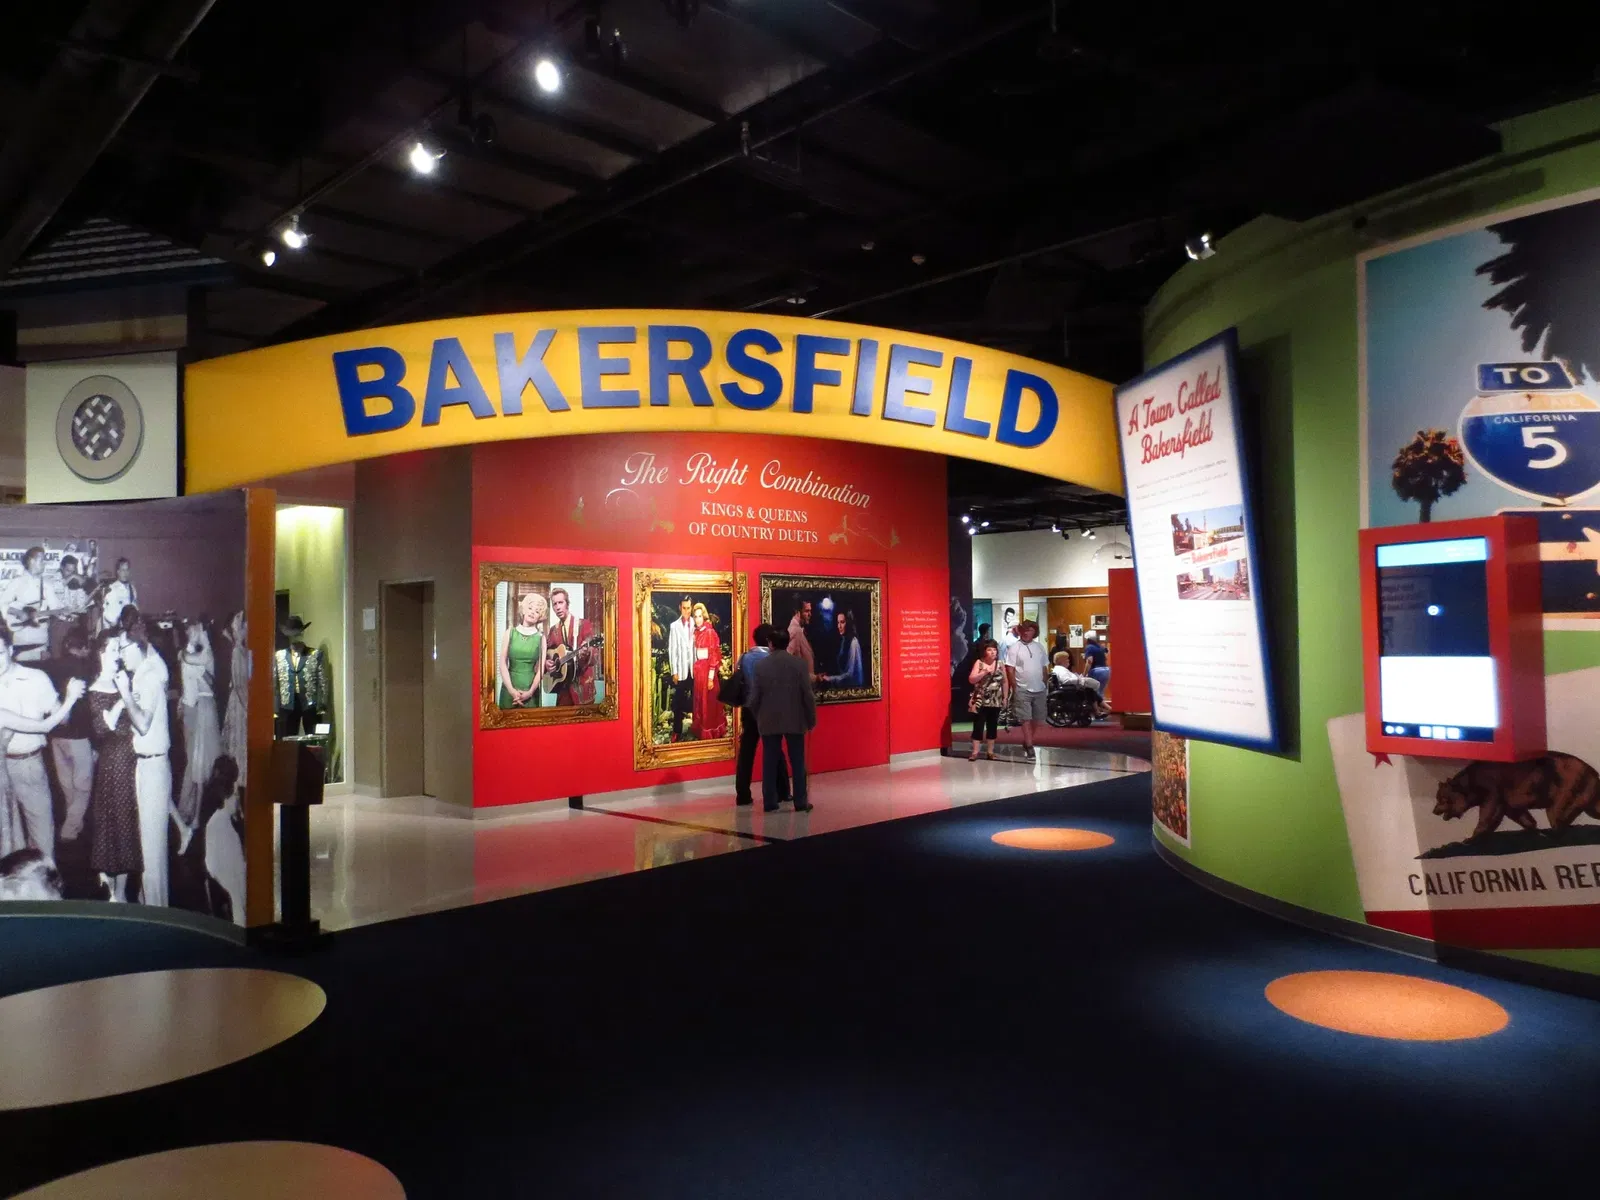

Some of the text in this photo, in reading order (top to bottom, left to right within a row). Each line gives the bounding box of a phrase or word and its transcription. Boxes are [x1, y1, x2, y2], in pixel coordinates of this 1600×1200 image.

[332, 325, 1060, 448] BAKERSFIELD
[1493, 367, 1550, 384] TO
[1128, 365, 1221, 436] A Town Called
[1141, 408, 1213, 464] Bakersfield
[1494, 414, 1577, 424] CALIFORNIA
[1522, 426, 1567, 469] 5
[620, 452, 871, 508] The Right Combination
[701, 501, 808, 524] KINGS & QUEENS
[689, 521, 818, 543] OF COUNTRY DUETS
[1408, 867, 1547, 895] CALIFORNIA
